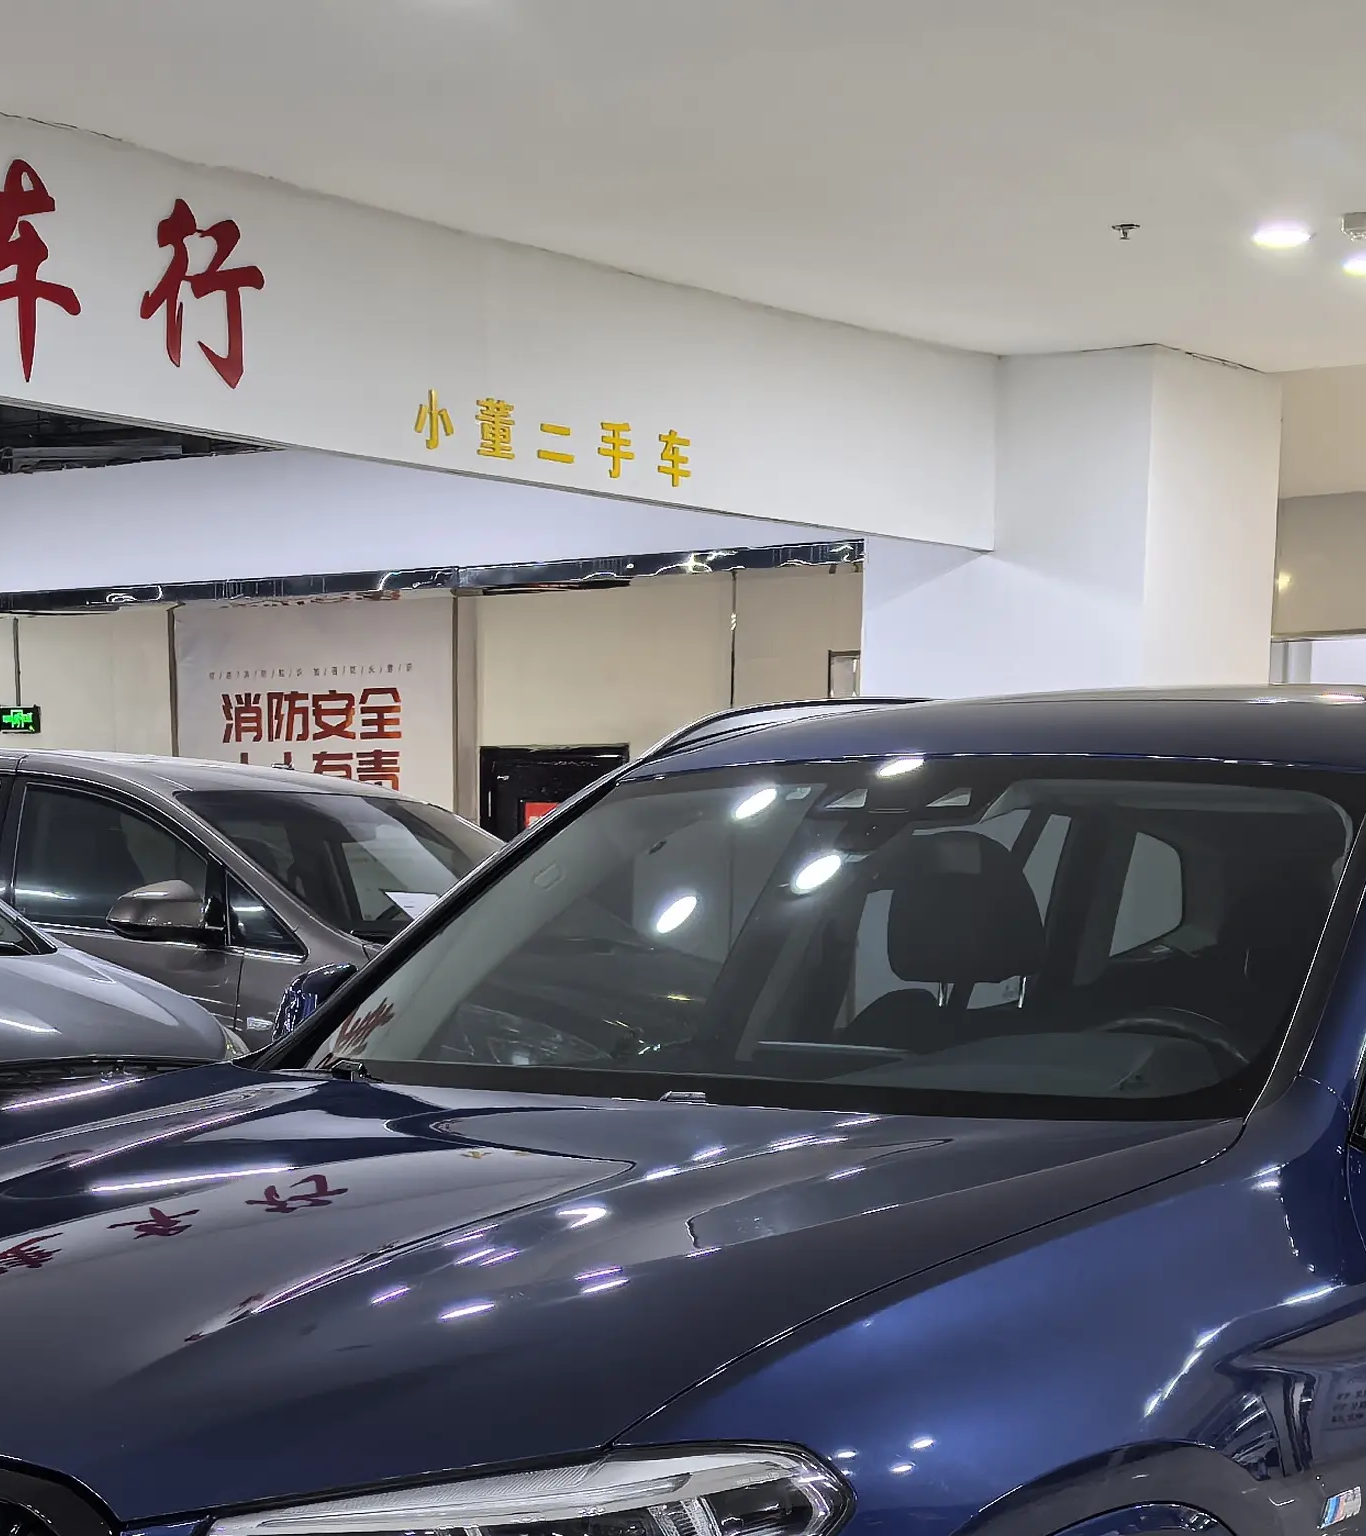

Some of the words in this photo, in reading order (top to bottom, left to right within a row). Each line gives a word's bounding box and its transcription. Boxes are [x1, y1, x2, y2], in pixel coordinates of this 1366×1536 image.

[414, 388, 691, 487] 小董二手车
[221, 687, 402, 744] 消防安全
